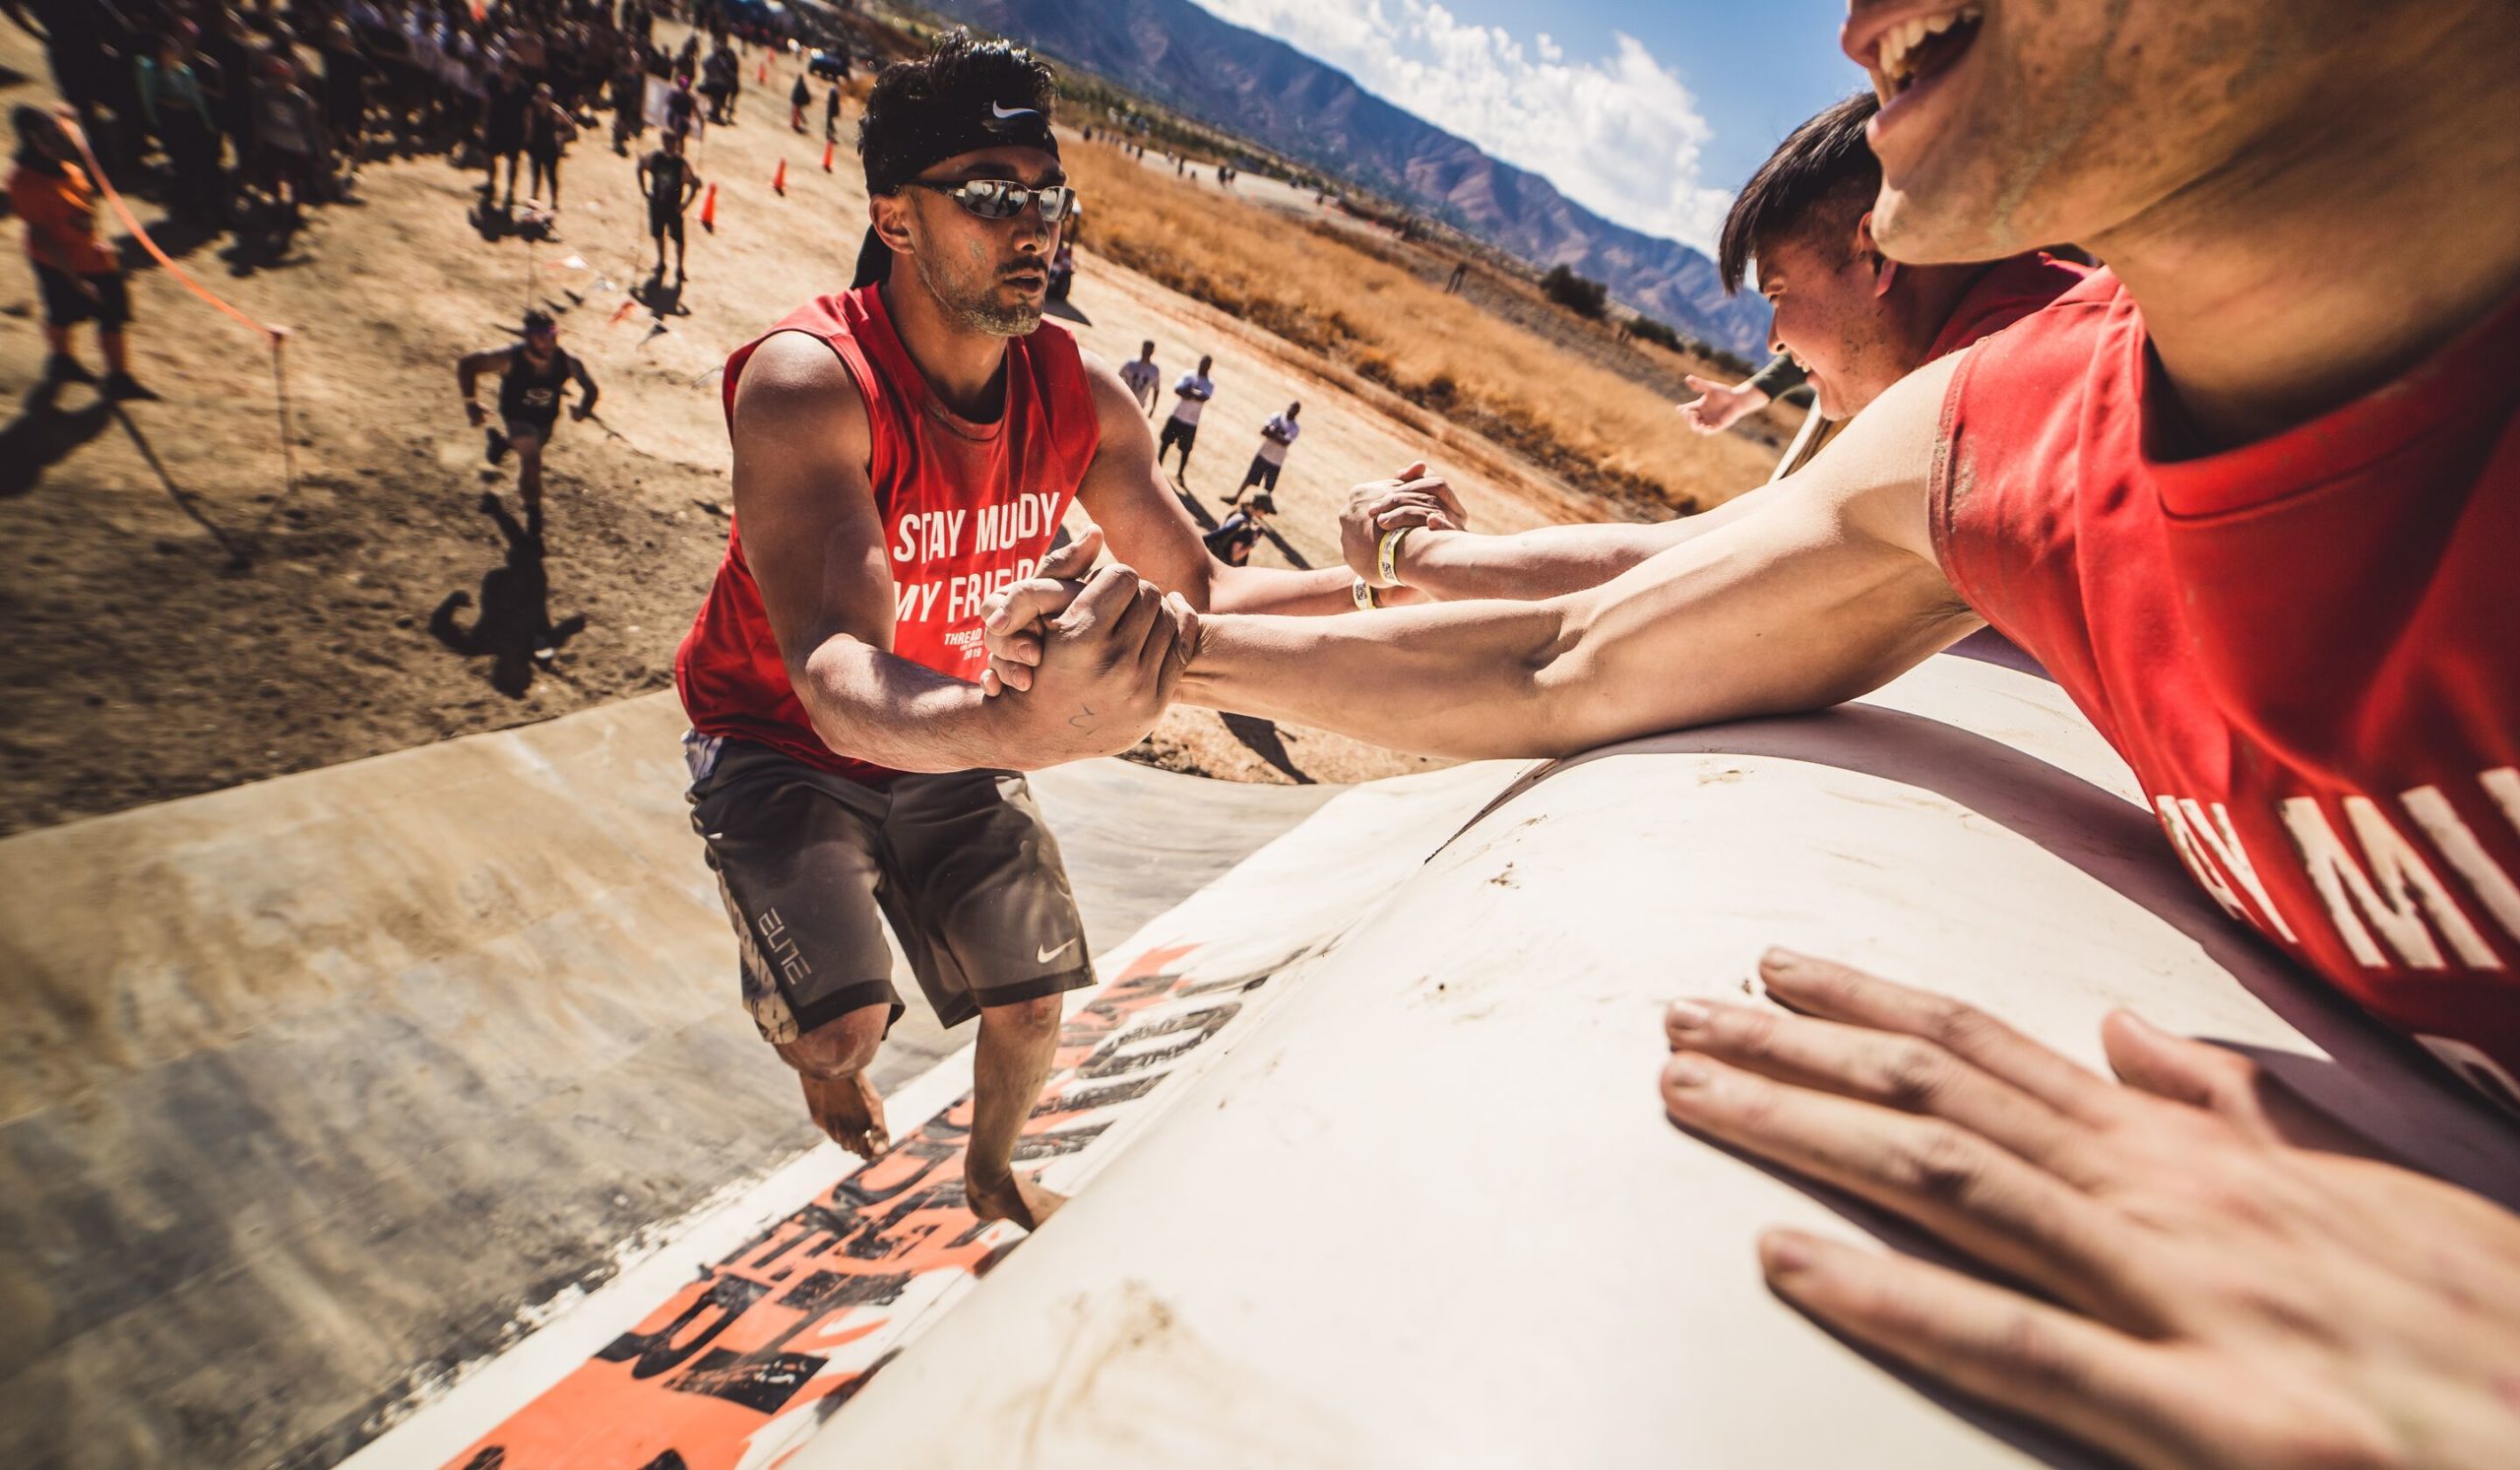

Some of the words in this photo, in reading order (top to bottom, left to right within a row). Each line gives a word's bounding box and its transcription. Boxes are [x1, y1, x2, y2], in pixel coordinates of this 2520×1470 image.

[893, 509, 967, 564] STAY
[893, 580, 942, 622] MY
[944, 628, 982, 645] THREAD
[758, 908, 811, 985] ELITE
[591, 972, 1183, 1380] MDDER
